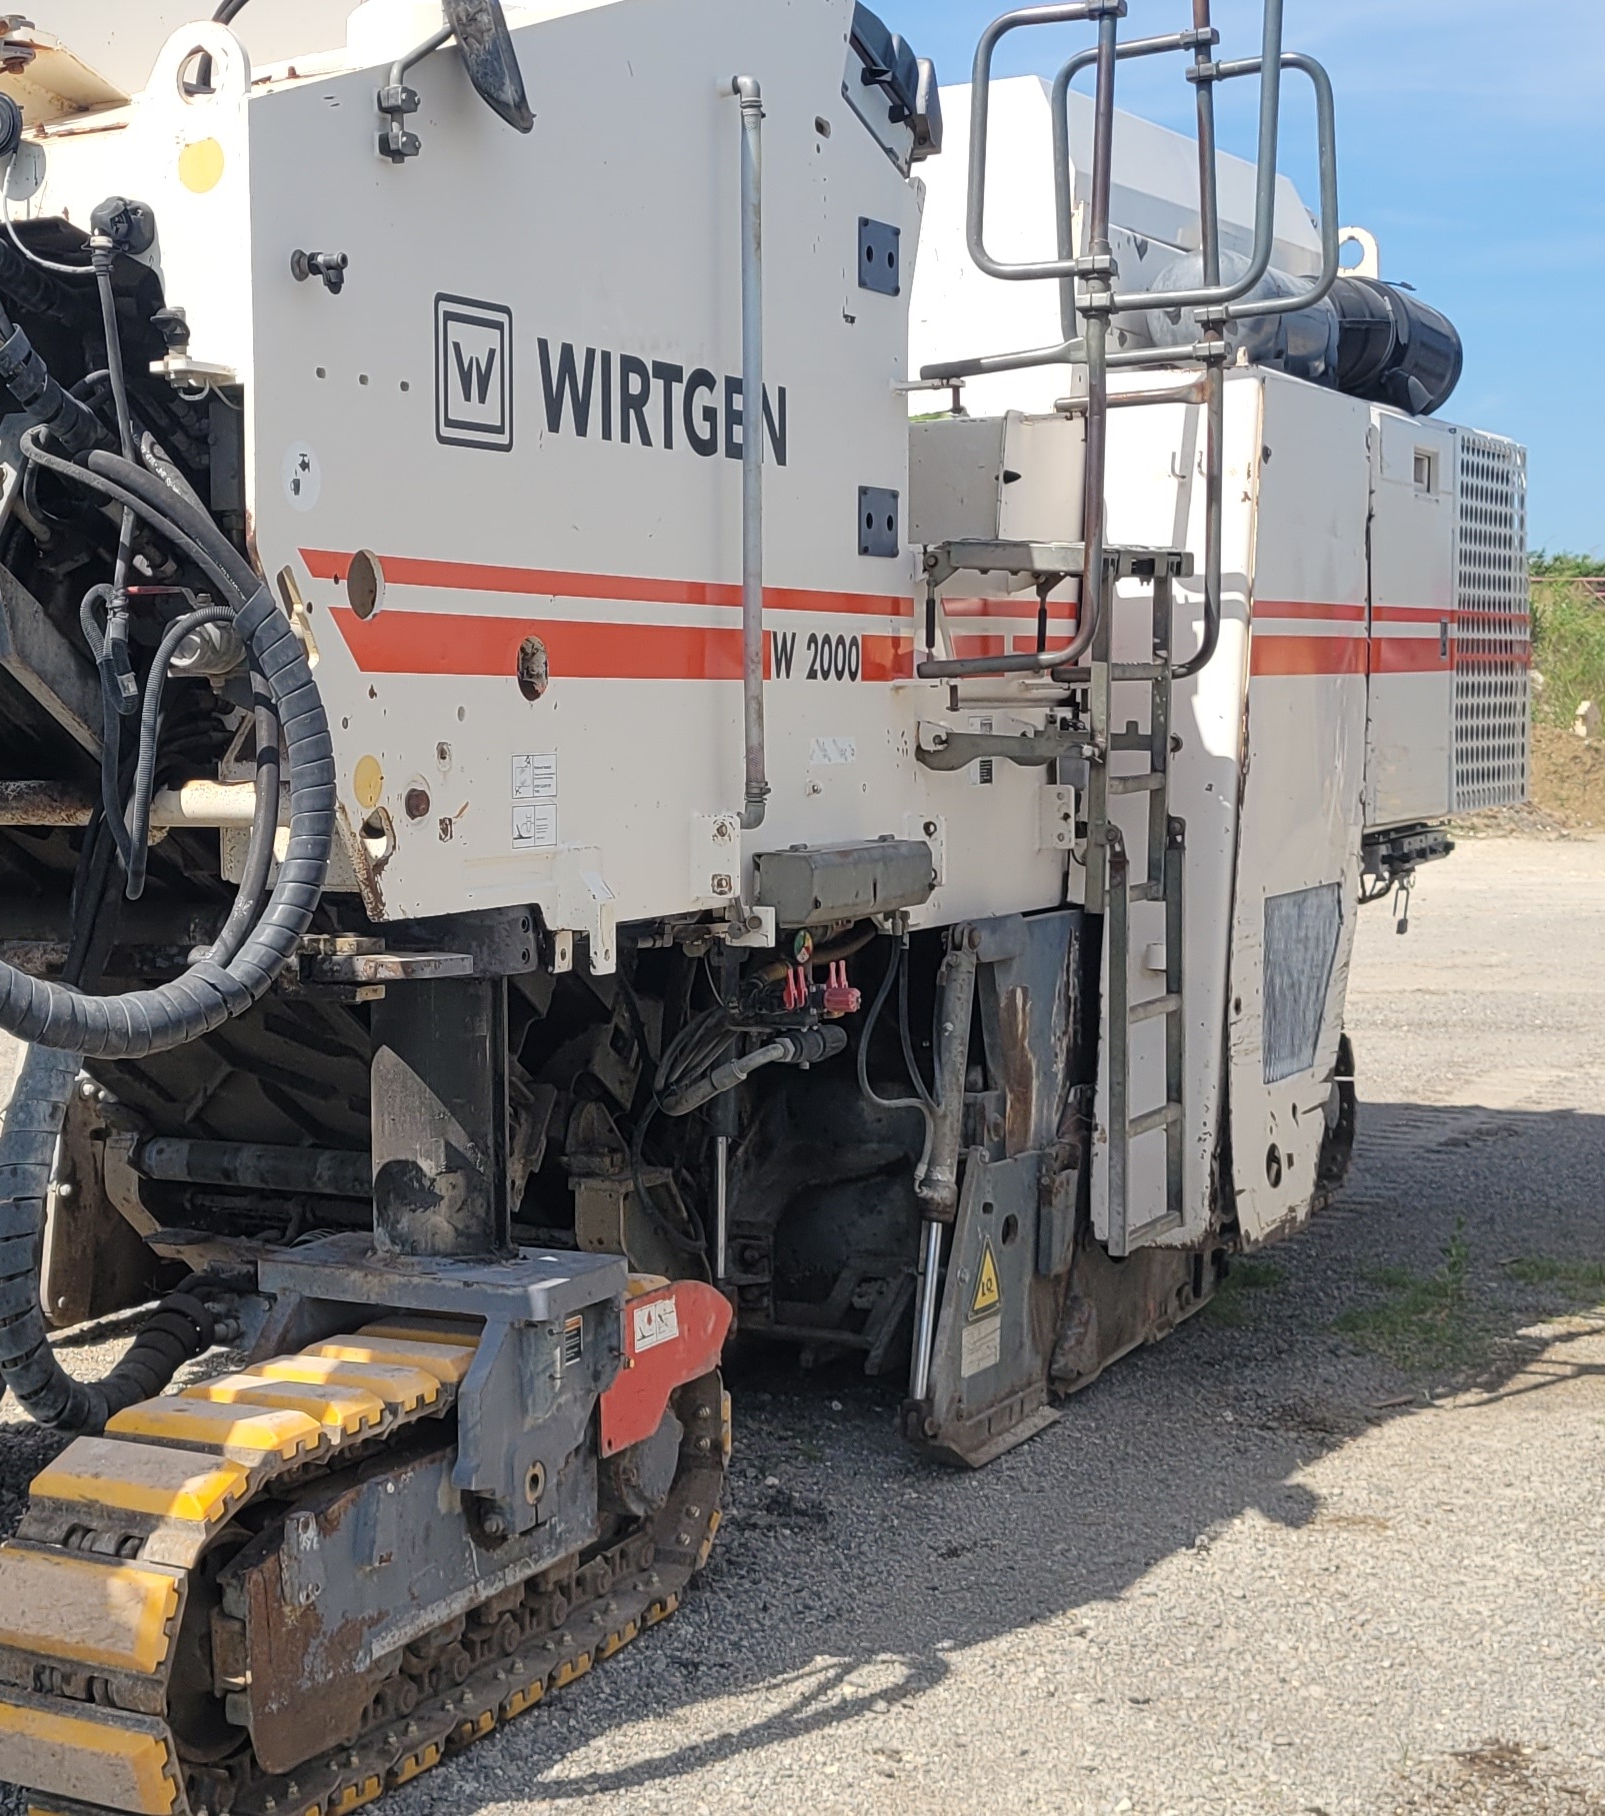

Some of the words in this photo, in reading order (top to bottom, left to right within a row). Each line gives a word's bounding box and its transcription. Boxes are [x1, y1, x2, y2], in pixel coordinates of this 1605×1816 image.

[452, 340, 497, 405] W
[537, 336, 787, 467] WIRTGEN
[771, 630, 797, 680] W
[805, 631, 860, 683] 2000
